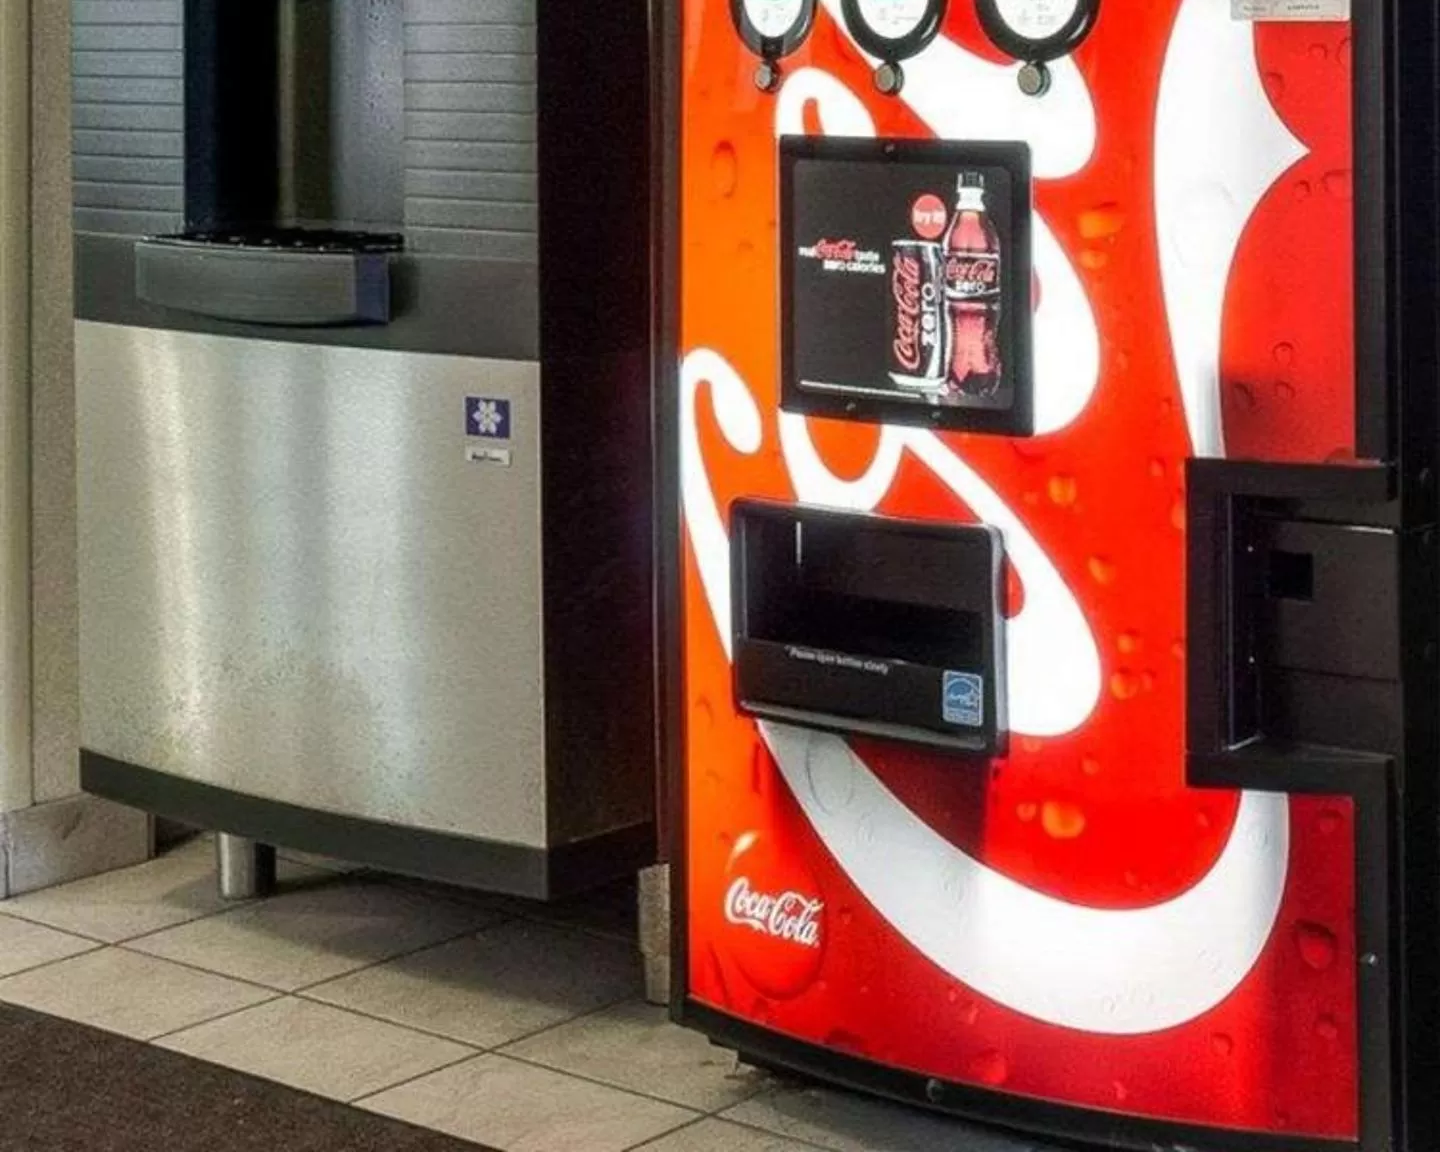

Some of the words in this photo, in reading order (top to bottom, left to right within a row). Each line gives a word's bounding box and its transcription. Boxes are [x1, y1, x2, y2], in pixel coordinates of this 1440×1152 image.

[893, 254, 920, 370] Coca-Cola
[922, 282, 937, 346] zero
[955, 280, 985, 294] zero
[724, 876, 824, 948] Coca-Cola
